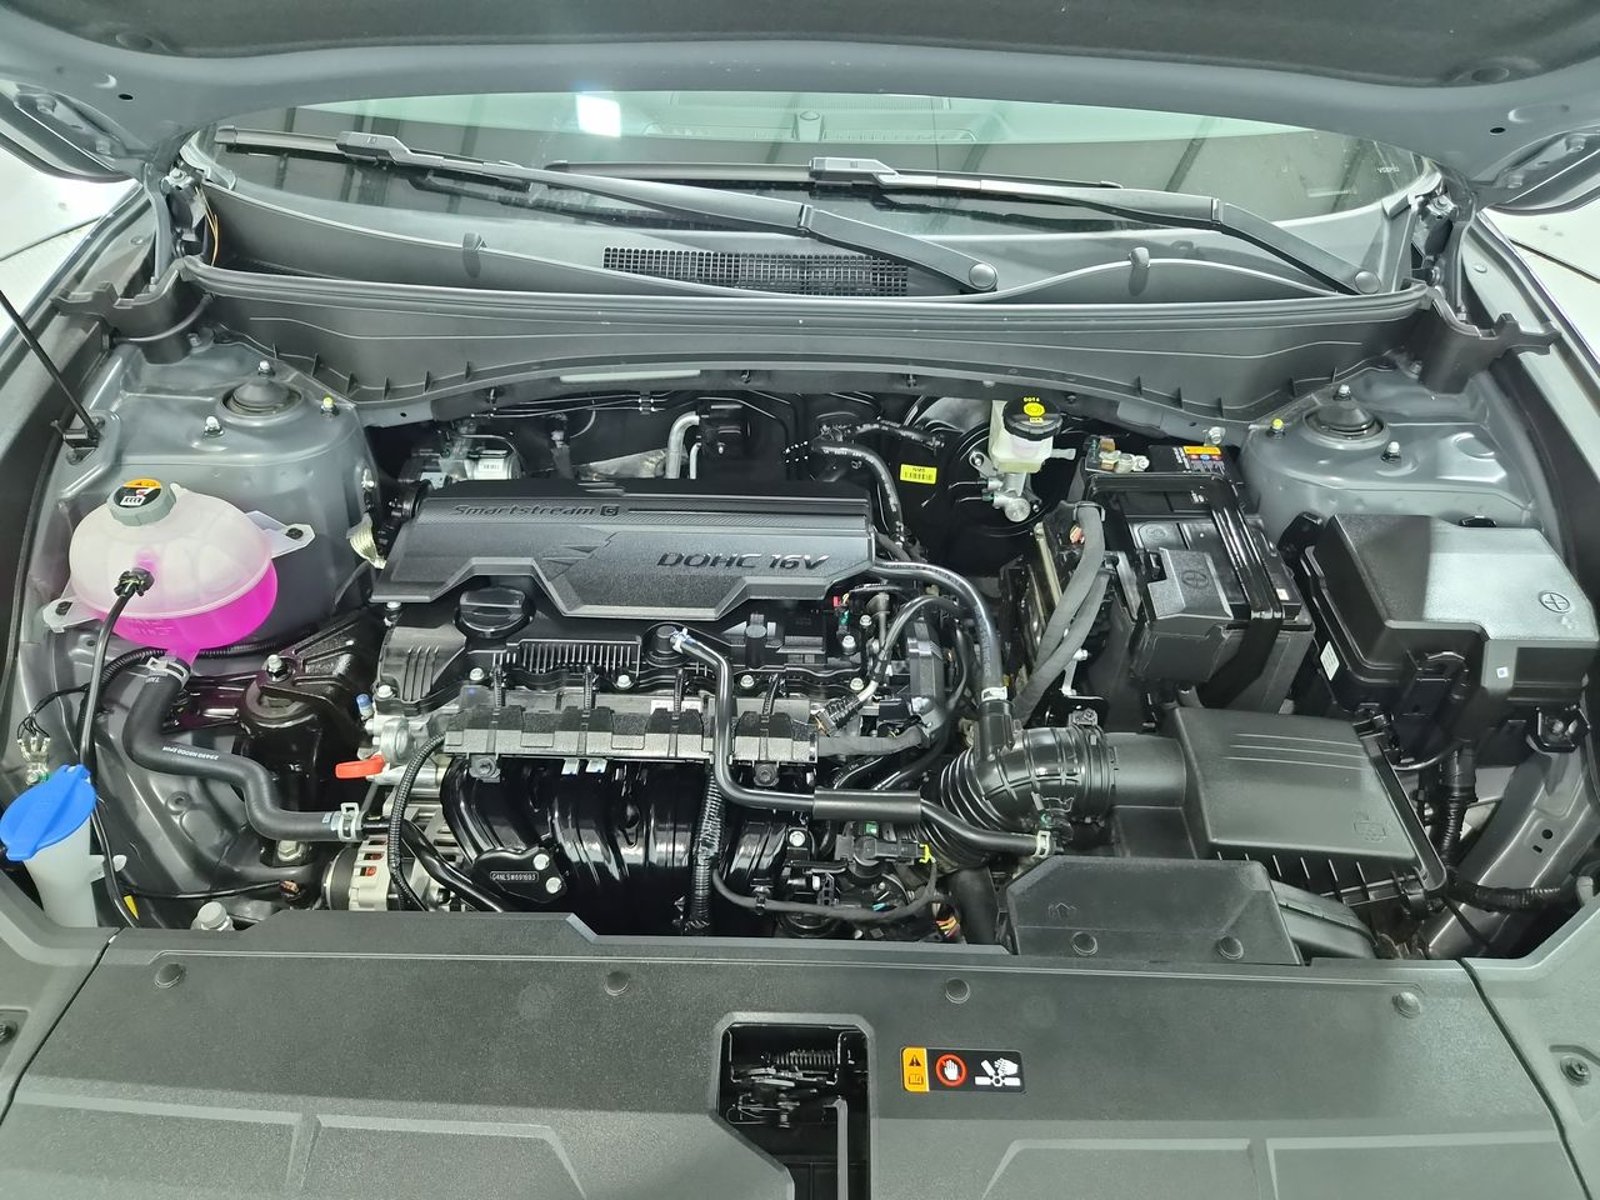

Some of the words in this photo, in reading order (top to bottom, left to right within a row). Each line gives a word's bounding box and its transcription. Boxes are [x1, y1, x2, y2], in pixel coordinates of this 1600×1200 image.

[453, 504, 596, 516] Smartstream
[656, 553, 762, 569] DOHC
[769, 554, 830, 570] 16V
